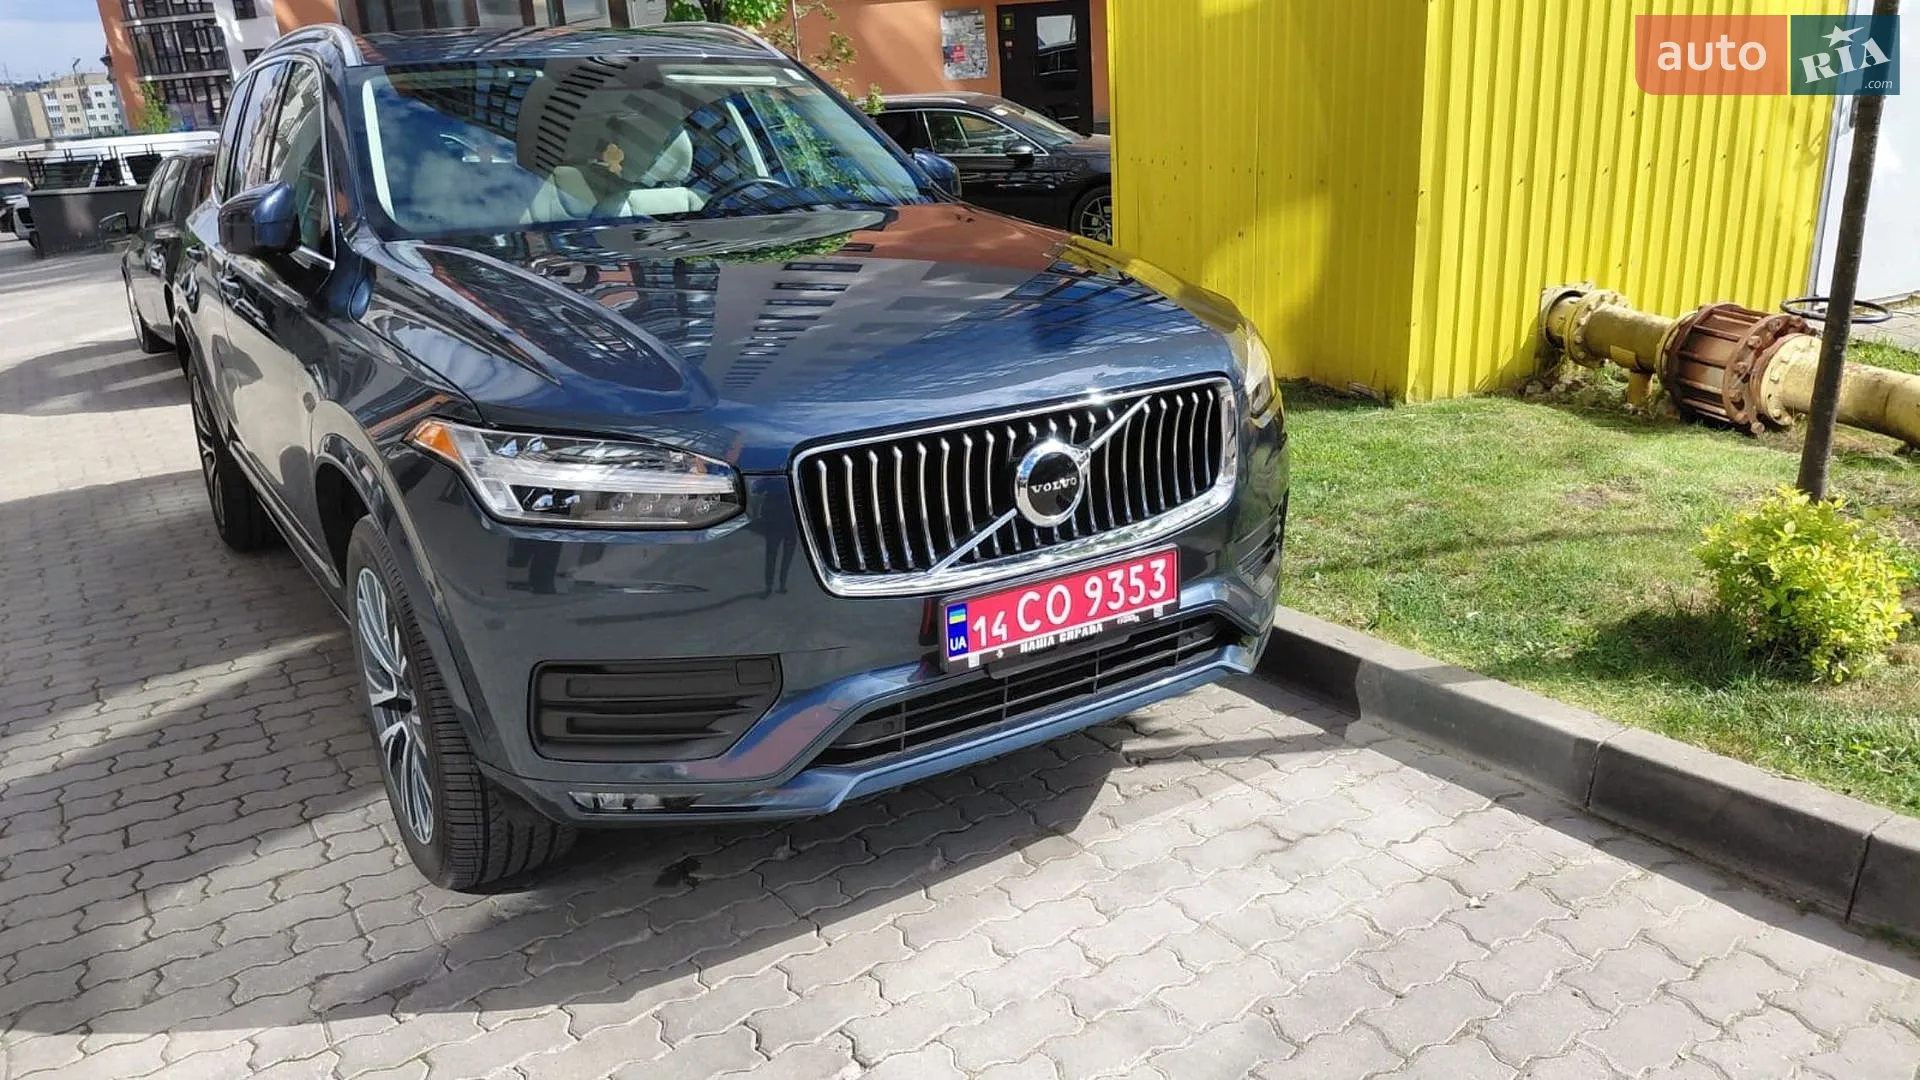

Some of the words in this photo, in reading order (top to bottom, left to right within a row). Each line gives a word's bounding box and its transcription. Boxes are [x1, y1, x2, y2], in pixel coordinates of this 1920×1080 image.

[1030, 477, 1077, 494] VOLVO
[973, 610, 1008, 647] 14
[1084, 558, 1167, 617] 9353
[949, 638, 967, 651] UA
